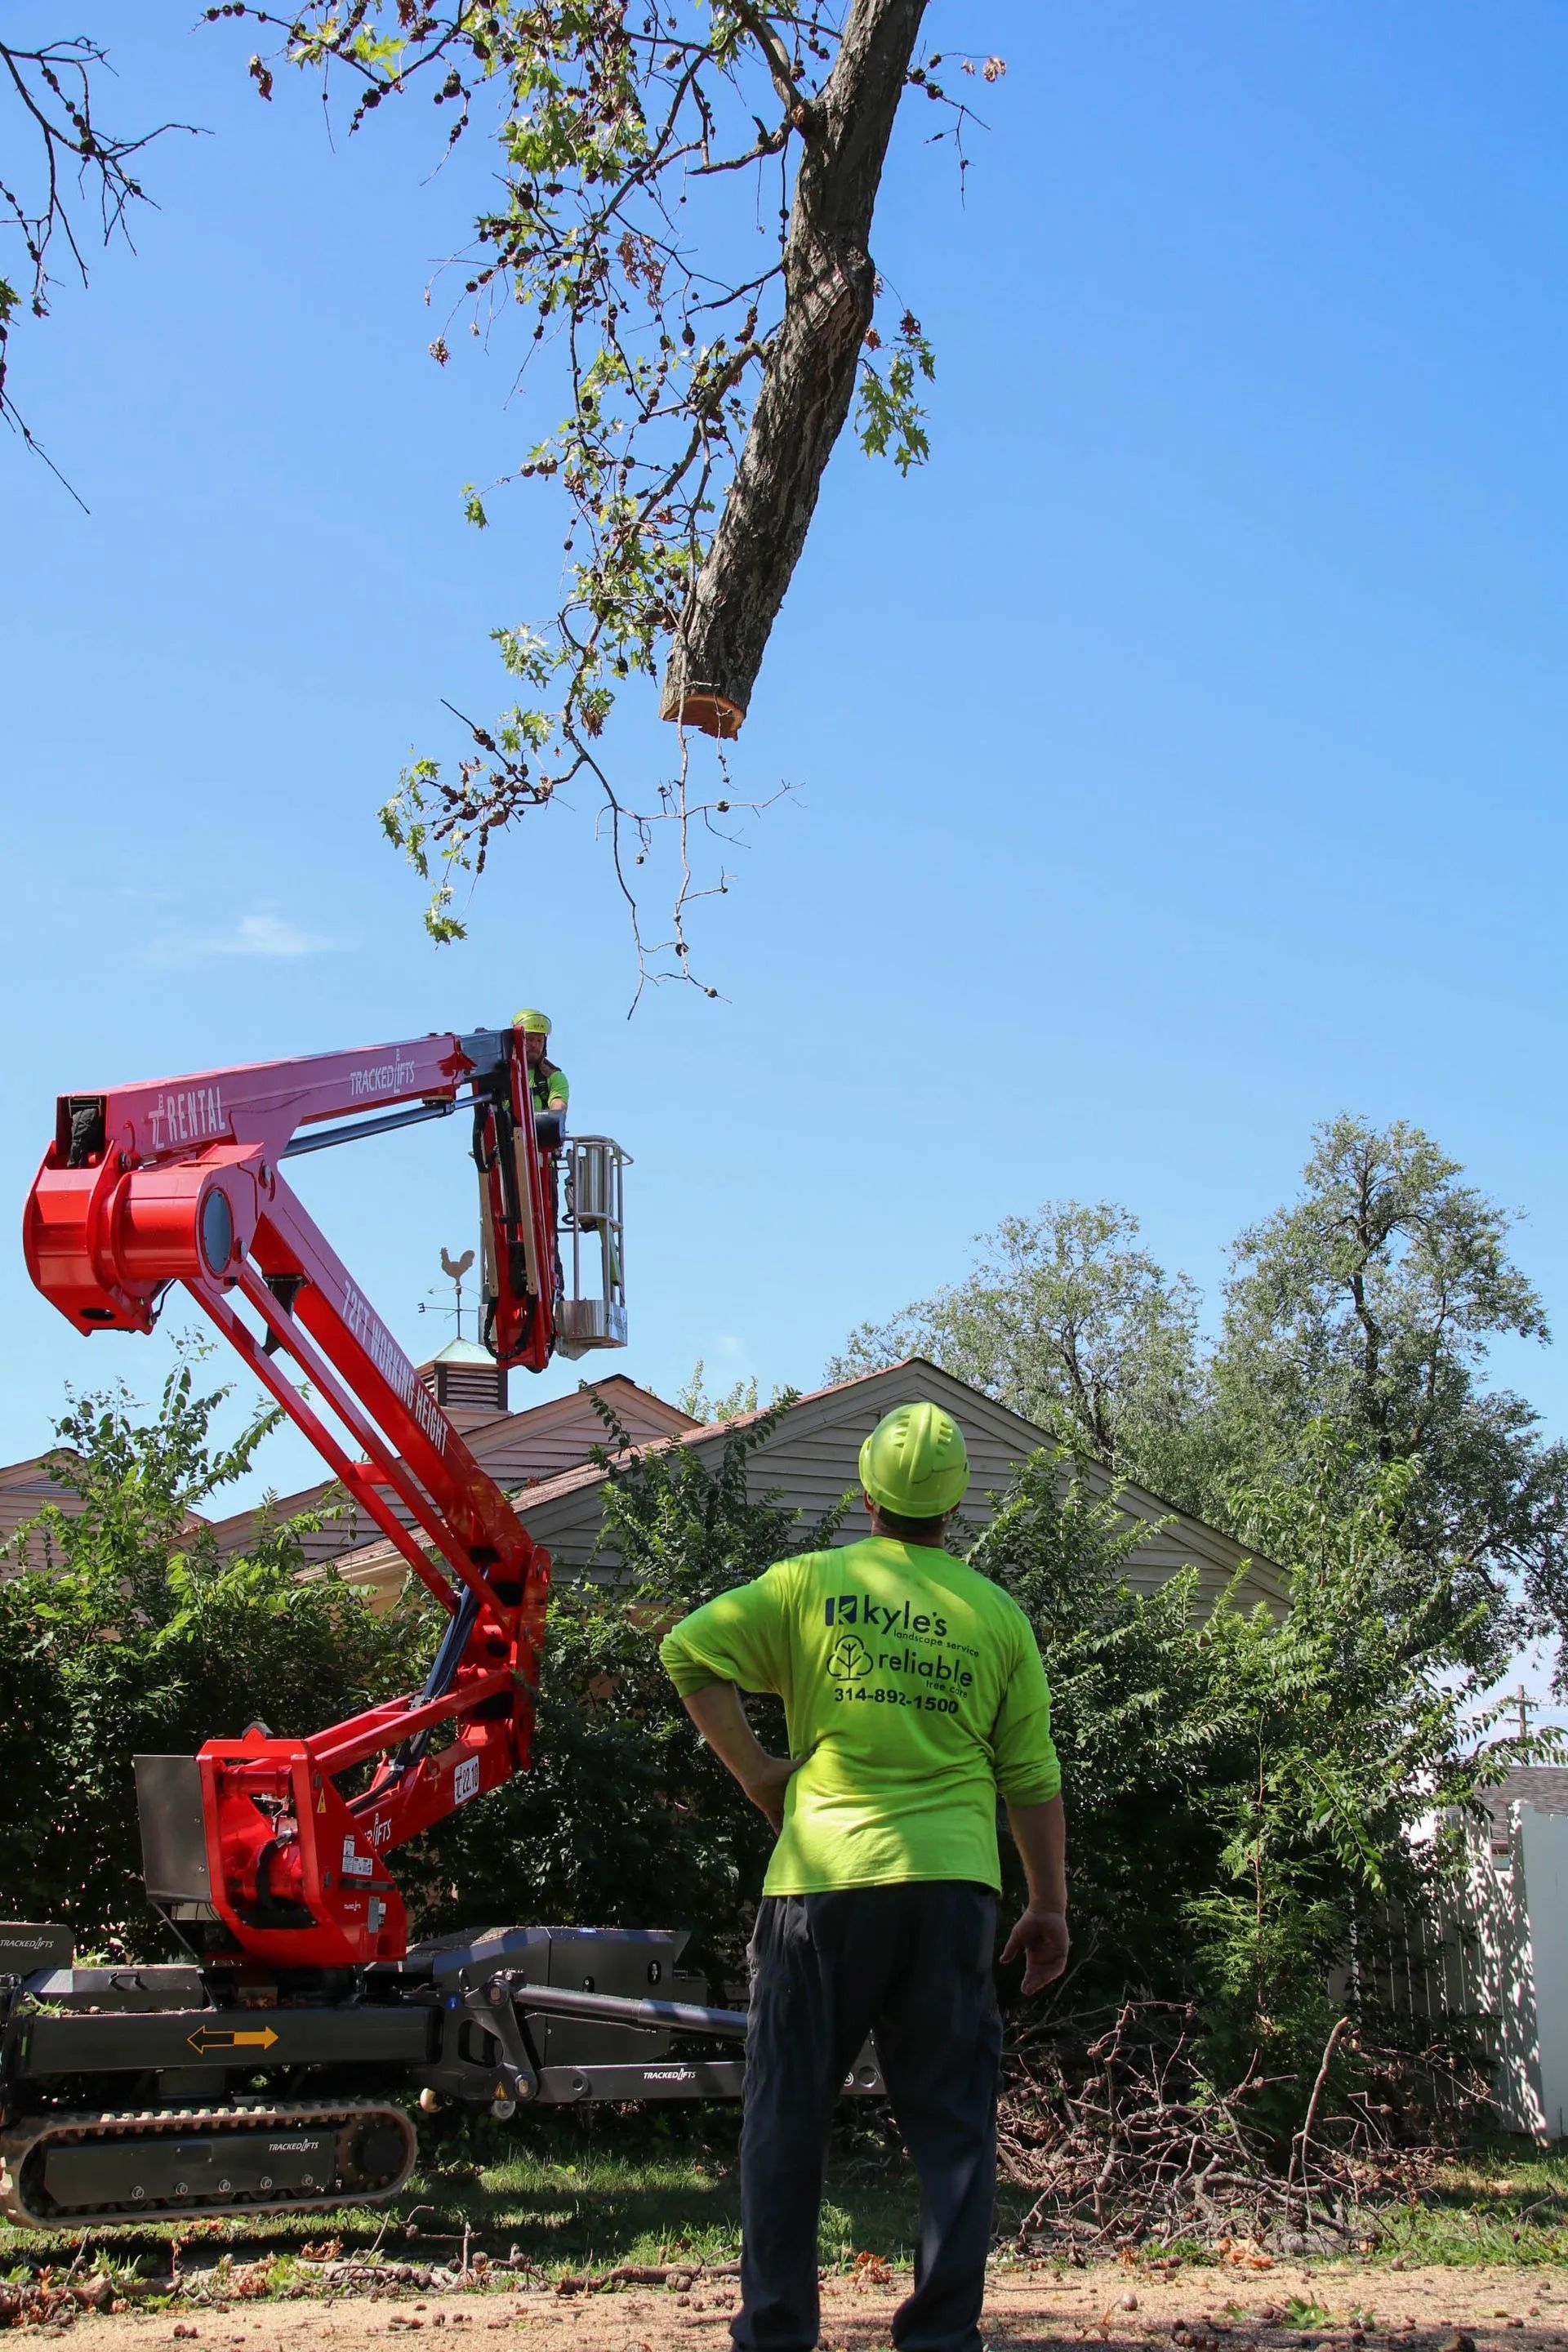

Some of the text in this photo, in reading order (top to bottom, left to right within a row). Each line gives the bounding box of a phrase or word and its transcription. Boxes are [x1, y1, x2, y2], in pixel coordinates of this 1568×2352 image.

[167, 1086, 226, 1143] RENTAL
[342, 1280, 449, 1458] 72FT WORKING HEIGHT
[864, 1595, 947, 1637] kyle's
[893, 1629, 979, 1658] landscape service
[879, 1648, 973, 1687] reliable
[834, 1687, 959, 1714] 314-892-1500
[926, 1680, 968, 1699] tree care
